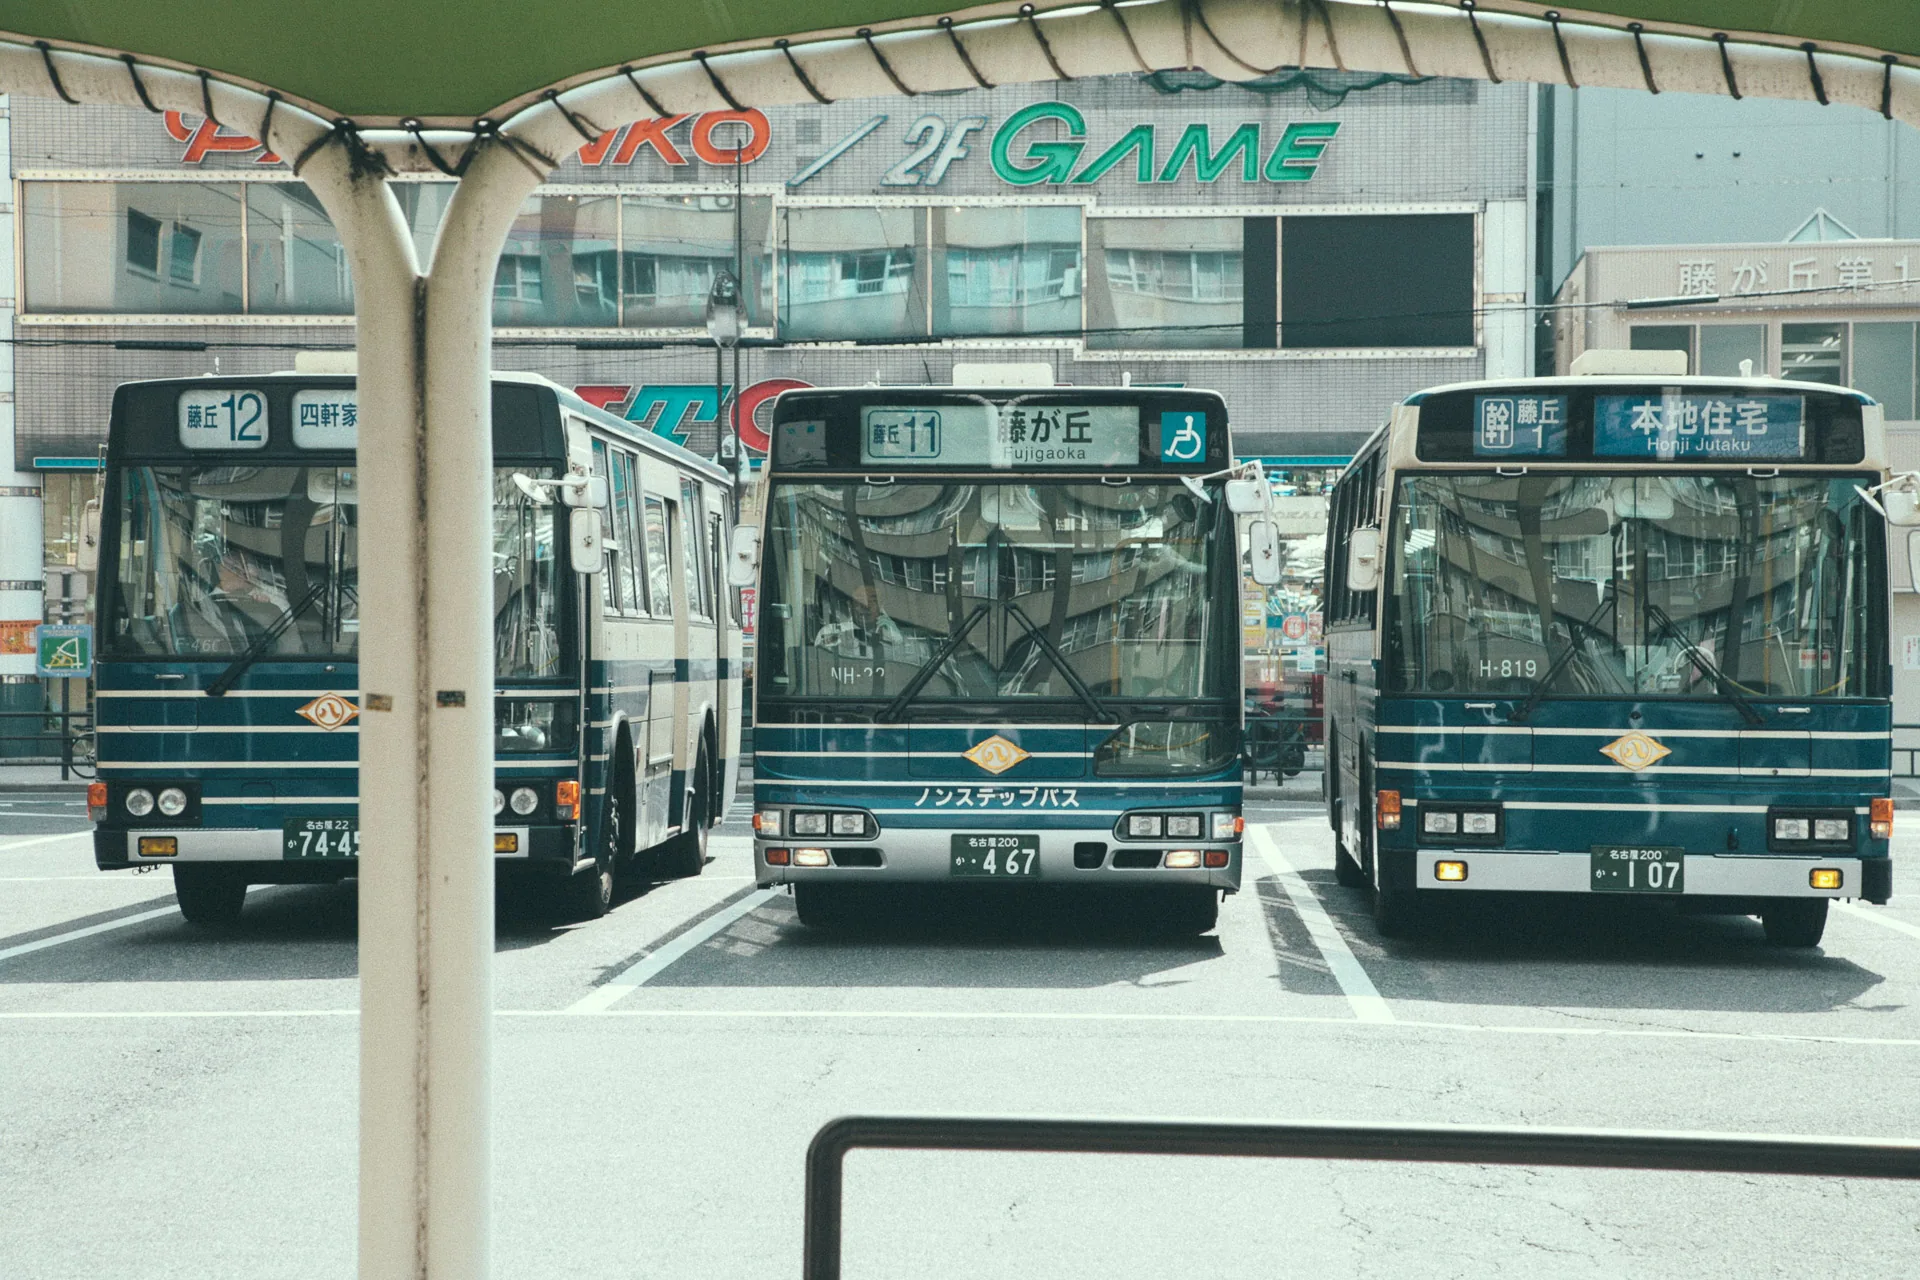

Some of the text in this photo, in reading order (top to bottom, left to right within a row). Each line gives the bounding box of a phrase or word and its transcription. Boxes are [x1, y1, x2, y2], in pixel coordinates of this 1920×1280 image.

[880, 113, 988, 187] 2F
[988, 101, 1343, 186] GAME
[300, 403, 357, 428] 四軒家
[1517, 399, 1560, 425] 藤丘
[1631, 400, 1768, 436] 本地住宅
[998, 409, 1093, 444] 藤が丘
[1003, 446, 1086, 462] Fujigaoka
[1647, 438, 1751, 455] Honji Jutaku
[1480, 659, 1537, 678] H-819
[914, 787, 1080, 808] ノンステップバス
